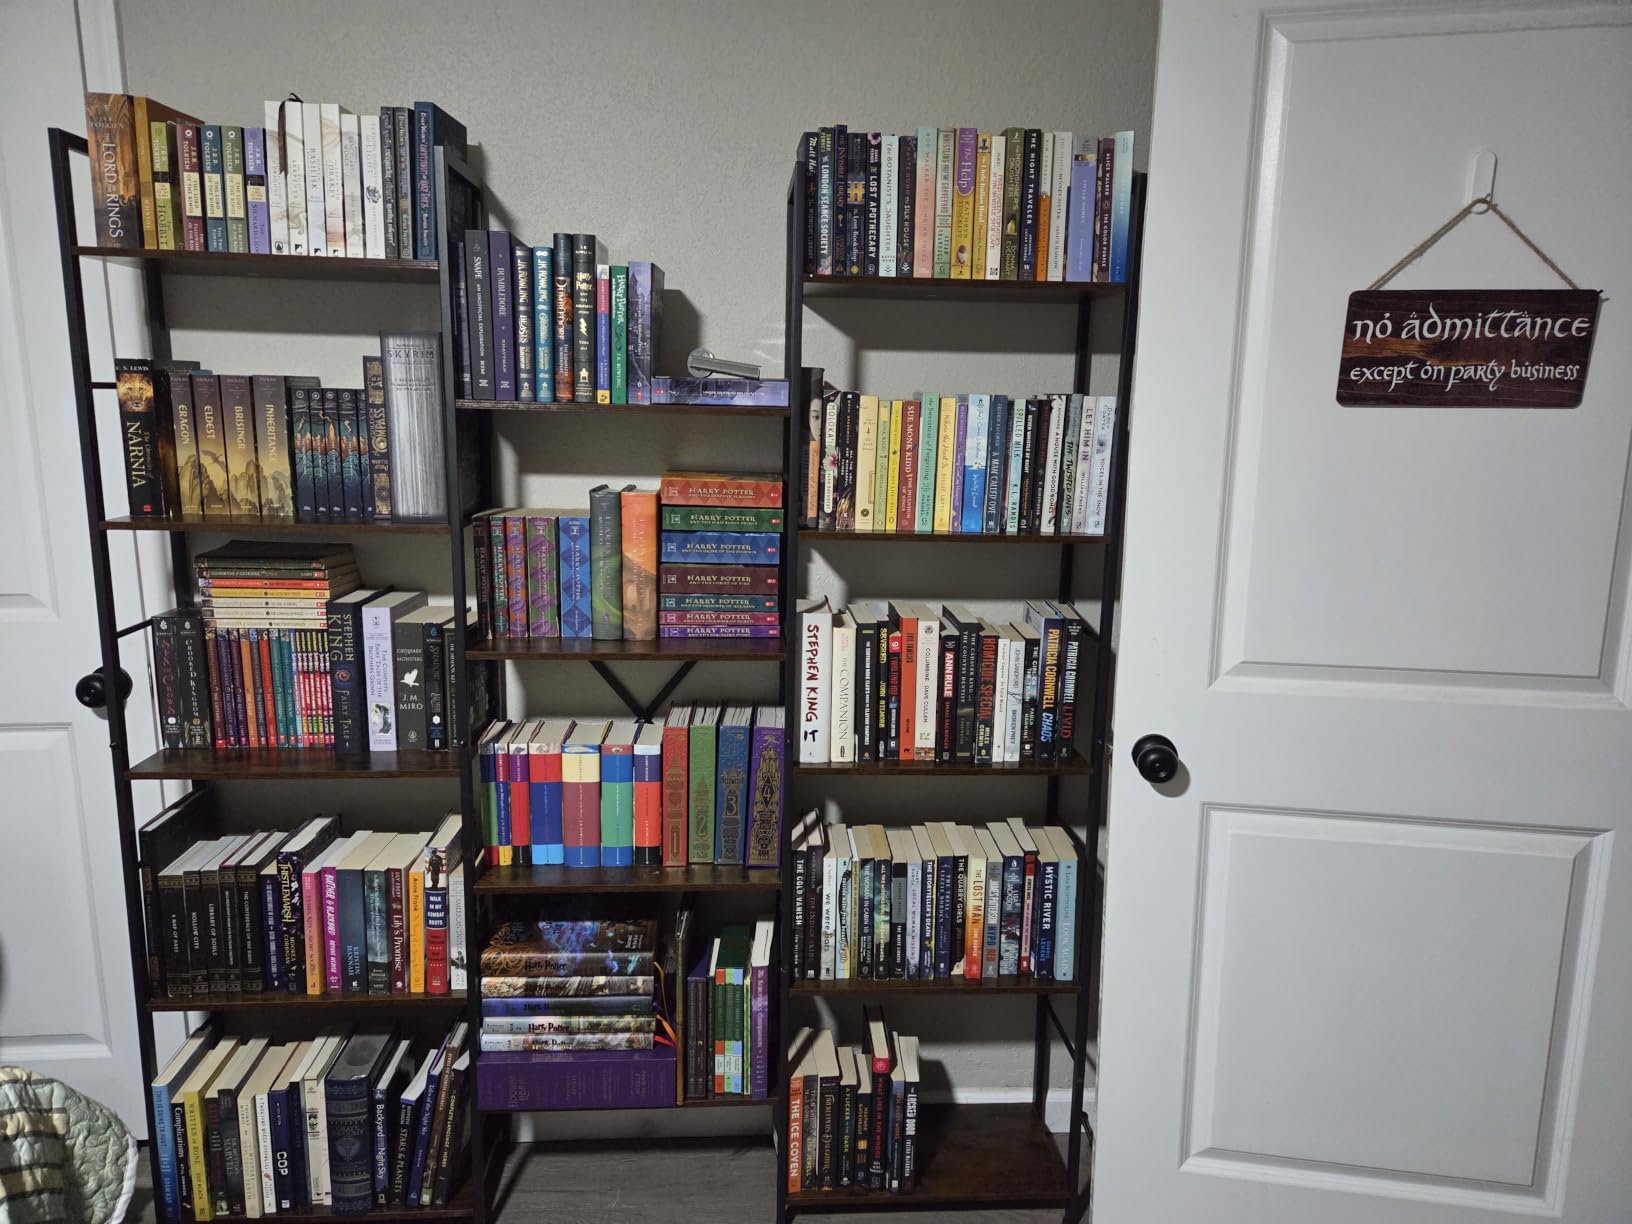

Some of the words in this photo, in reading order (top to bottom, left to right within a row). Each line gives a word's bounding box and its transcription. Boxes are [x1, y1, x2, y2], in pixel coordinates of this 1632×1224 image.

[809, 136, 818, 157] Matt
[102, 143, 117, 183] LORD
[959, 162, 971, 188] Help
[821, 165, 830, 194] LONDON
[869, 176, 877, 198] LOST
[108, 194, 123, 238] RINGS
[1026, 183, 1034, 224] TRAVELER
[158, 205, 168, 246] HOBBIT
[820, 224, 830, 255] SOCIETY
[868, 202, 877, 258] APOTHECARY
[473, 256, 482, 279] SNAPE
[497, 268, 506, 316] DUMBLEDORE
[518, 270, 529, 302] ROWLING
[538, 270, 549, 302] ROWLING
[556, 277, 568, 340] DUMBLEDORE
[1350, 360, 1419, 392] except
[1446, 359, 1505, 392] party
[178, 405, 189, 444] ERAGON
[204, 406, 215, 439] ELDEST
[234, 406, 246, 449] BRISINGR
[1085, 408, 1093, 425] LET
[265, 404, 278, 464] INHERITANCE
[1014, 441, 1023, 458] MILK
[1083, 429, 1092, 447] HIM
[127, 421, 145, 488] NARNIA
[1081, 451, 1090, 461] IN
[989, 476, 998, 499] CALLED
[988, 501, 996, 514] OVE
[329, 615, 342, 660] KING
[343, 614, 354, 661] STEPHEN
[805, 624, 819, 681] STEPHEN
[1046, 629, 1060, 664] PATRICIA
[185, 640, 197, 678] CROOKED
[945, 653, 953, 673] ANN
[980, 638, 995, 683] HOMICIDE
[1065, 641, 1078, 670] PATRICIA
[190, 680, 199, 717] KINGDOM
[944, 674, 953, 697] RULE
[1042, 666, 1056, 709] CORNWELL
[1063, 671, 1075, 704] CORNWELL
[805, 687, 819, 723] KING
[839, 669, 849, 740] COMPANION
[979, 685, 992, 720] SPECIAL
[803, 730, 818, 743] IT
[1041, 712, 1054, 742] CHAOS
[1061, 705, 1072, 738] LIVID
[796, 859, 804, 874] THE
[1044, 866, 1054, 899] MYSTIC
[278, 863, 295, 922] THISTLEMARSH
[796, 876, 804, 895] COLD
[972, 880, 984, 902] LOST
[392, 915, 404, 934] Lily's
[795, 897, 803, 925] VANISH
[971, 905, 982, 924] MAN
[1042, 902, 1052, 929] RIVER
[353, 946, 361, 975] KRISTIN
[394, 937, 403, 971] Promise
[528, 1023, 546, 1032] Harry
[547, 1022, 570, 1032] Potter
[375, 1104, 385, 1137] Backyard
[791, 1099, 800, 1119] THE
[907, 1094, 917, 1118] LOCKED
[175, 1108, 185, 1158] Complications
[399, 1128, 408, 1152] STARS
[791, 1123, 800, 1139] ICE
[905, 1118, 916, 1136] DOOR
[277, 1151, 288, 1175] COP
[376, 1147, 385, 1166] Night
[790, 1142, 799, 1177] COVEN
[377, 1167, 385, 1179] Sky
[394, 1161, 405, 1193] PLANETS
